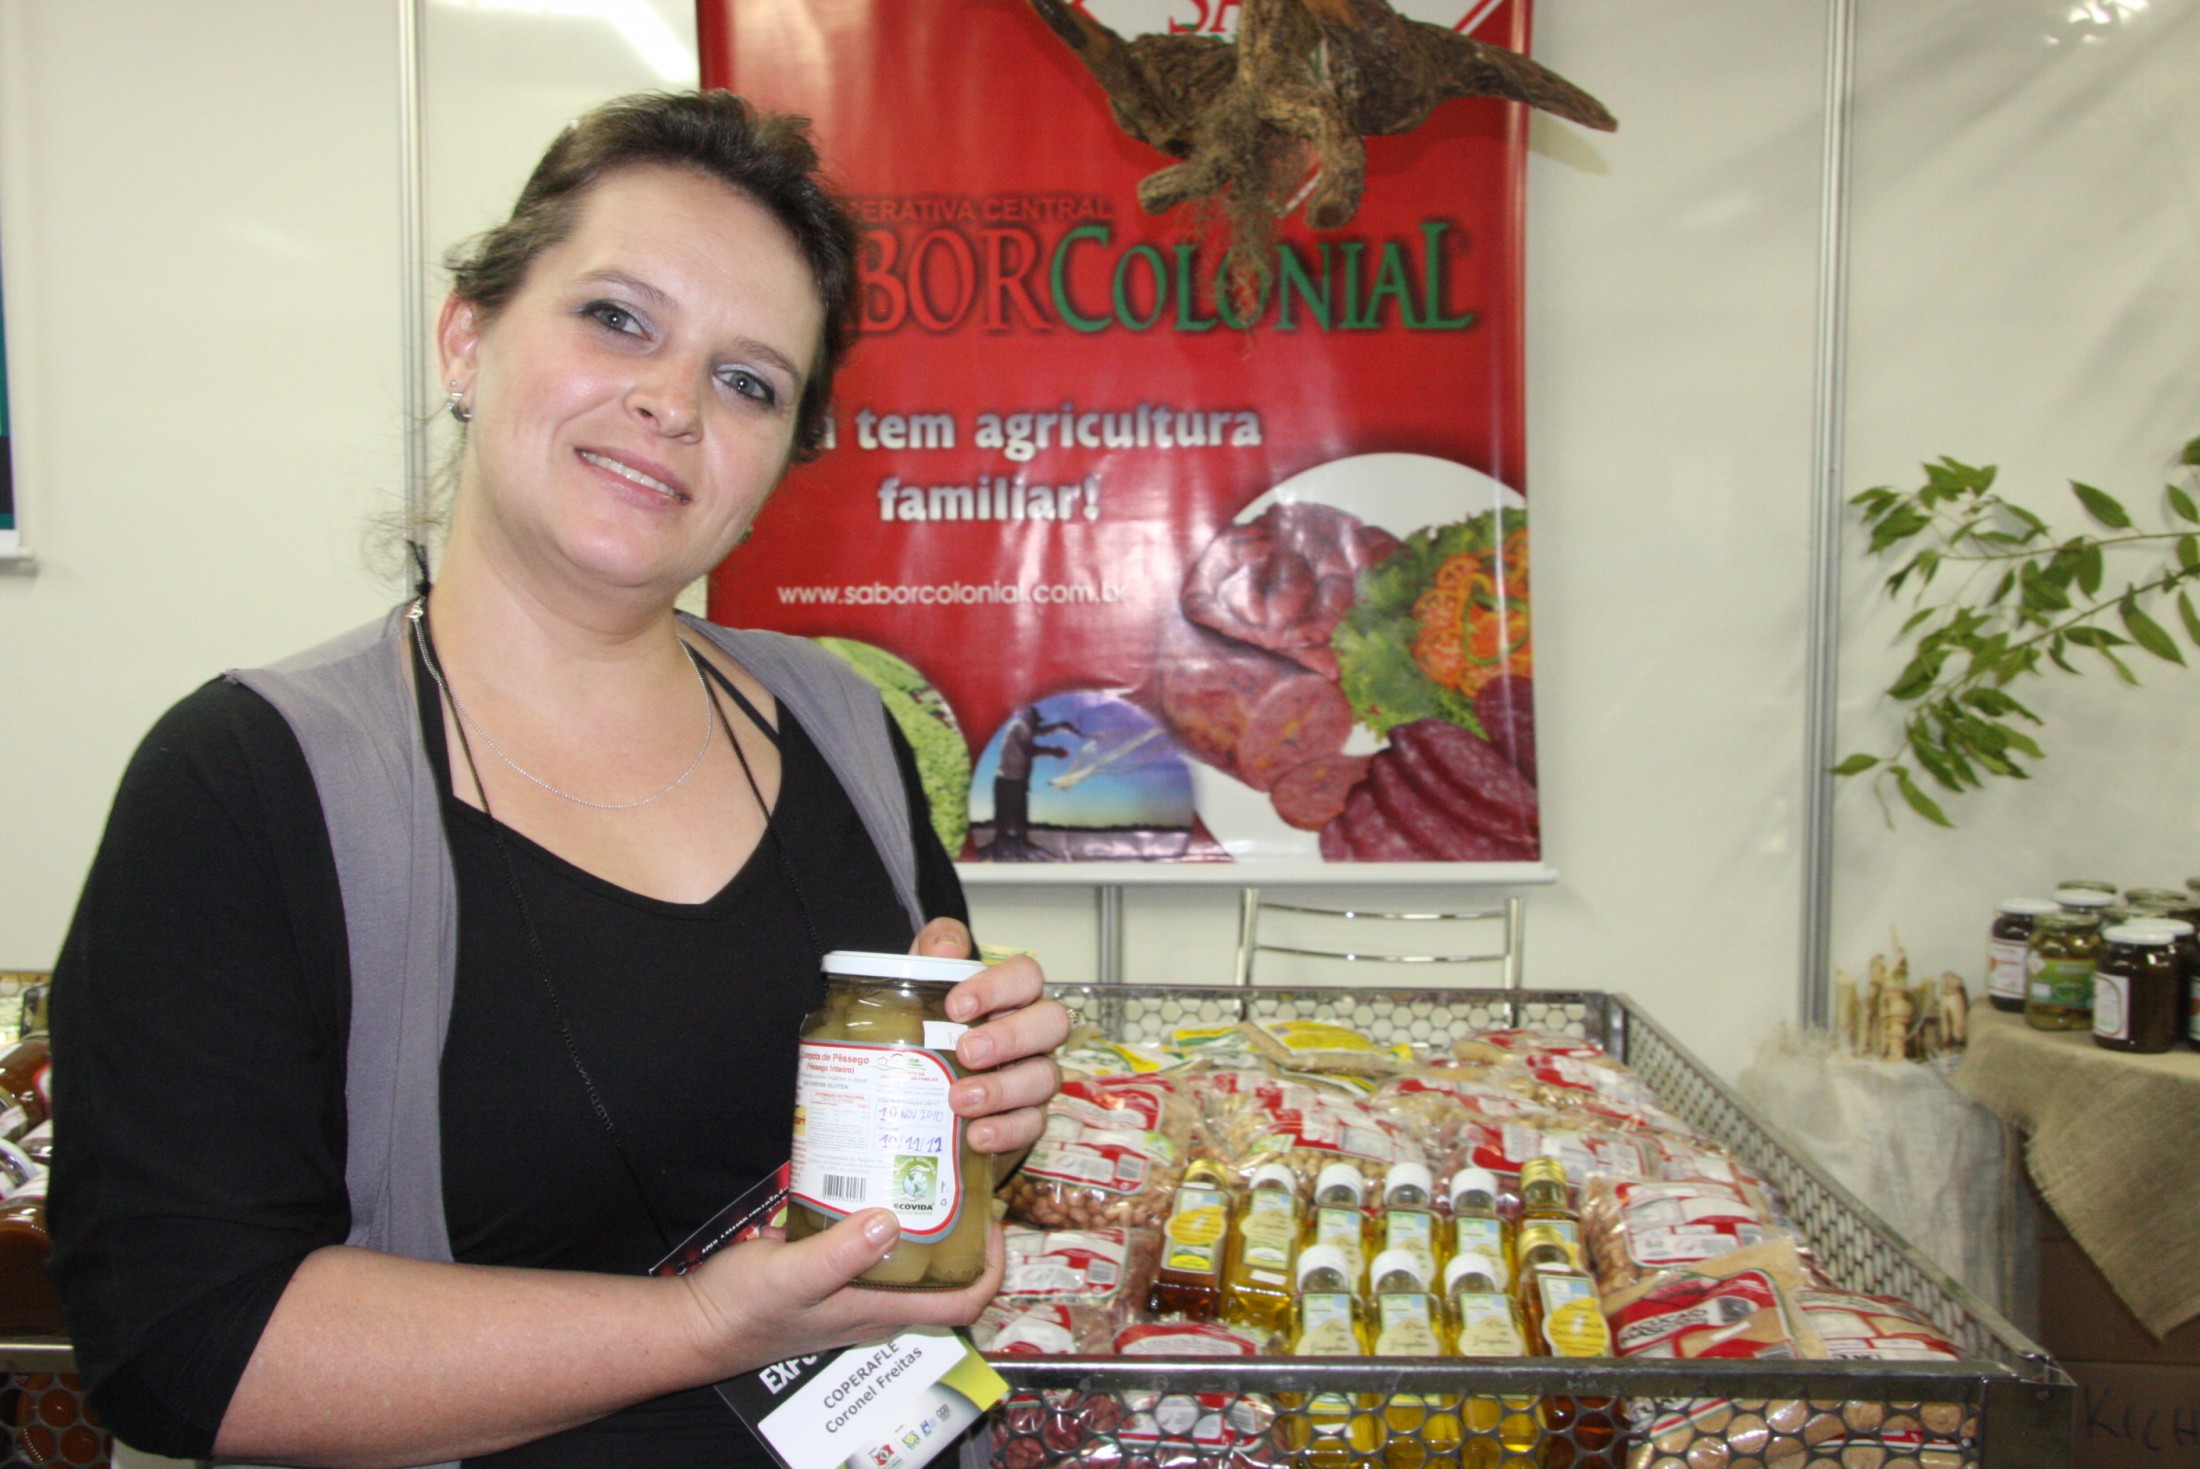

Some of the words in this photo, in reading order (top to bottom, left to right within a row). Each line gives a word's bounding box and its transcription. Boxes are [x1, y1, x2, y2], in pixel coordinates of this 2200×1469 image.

[980, 200, 1108, 221] CENTRAL
[856, 407, 955, 449] tem
[975, 404, 1262, 461] agricultura
[879, 476, 1100, 522] familiar!
[832, 1052, 870, 1066] Pêssego
[893, 1203, 933, 1211] ECOVIDA
[823, 1342, 900, 1409] COPERAFLE
[825, 1385, 878, 1433] Coronel
[875, 1347, 923, 1389] Freitas
